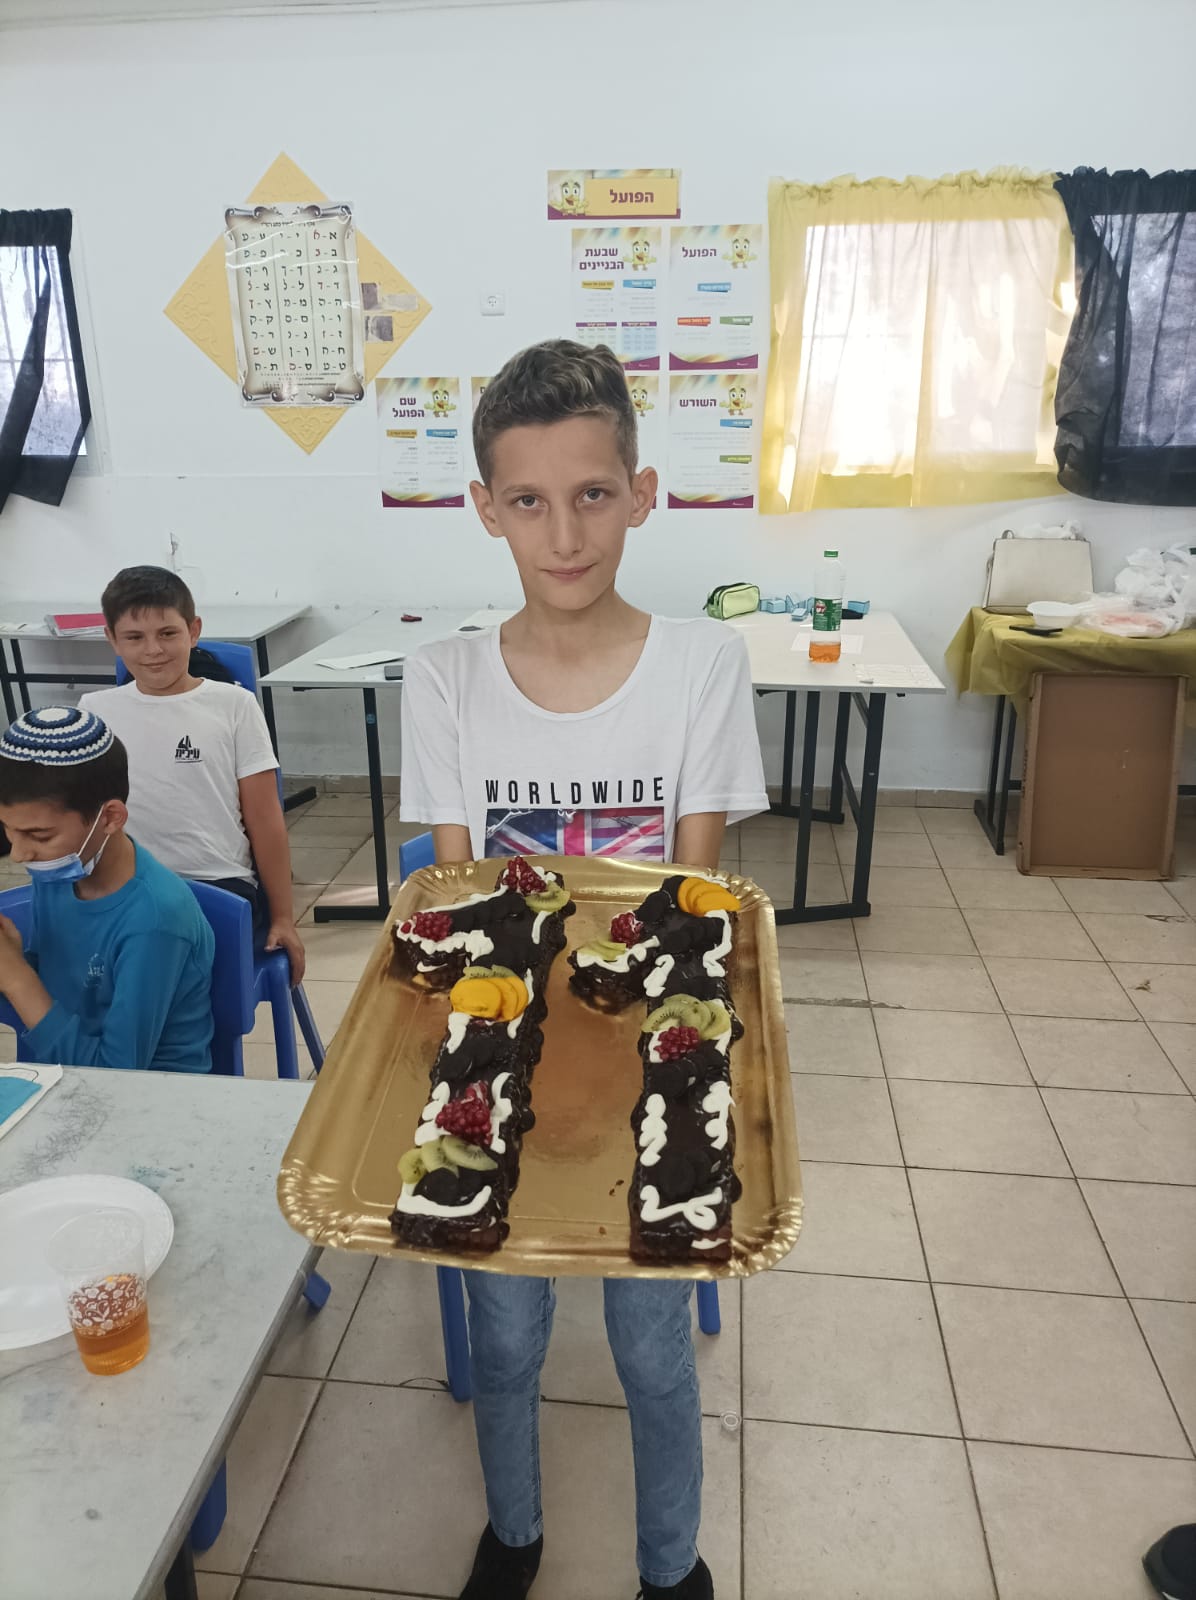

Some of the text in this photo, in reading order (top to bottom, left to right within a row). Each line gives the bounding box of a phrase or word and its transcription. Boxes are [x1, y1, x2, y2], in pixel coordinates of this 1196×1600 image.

[609, 189, 655, 204] הפועל
[584, 247, 618, 257] שבעת
[682, 246, 717, 258] הפועל
[578, 261, 625, 270] הבניינים
[400, 397, 416, 406] שם
[679, 398, 717, 408] השורש
[392, 407, 425, 418] הפועל
[485, 776, 664, 805] WORLDWIDE
